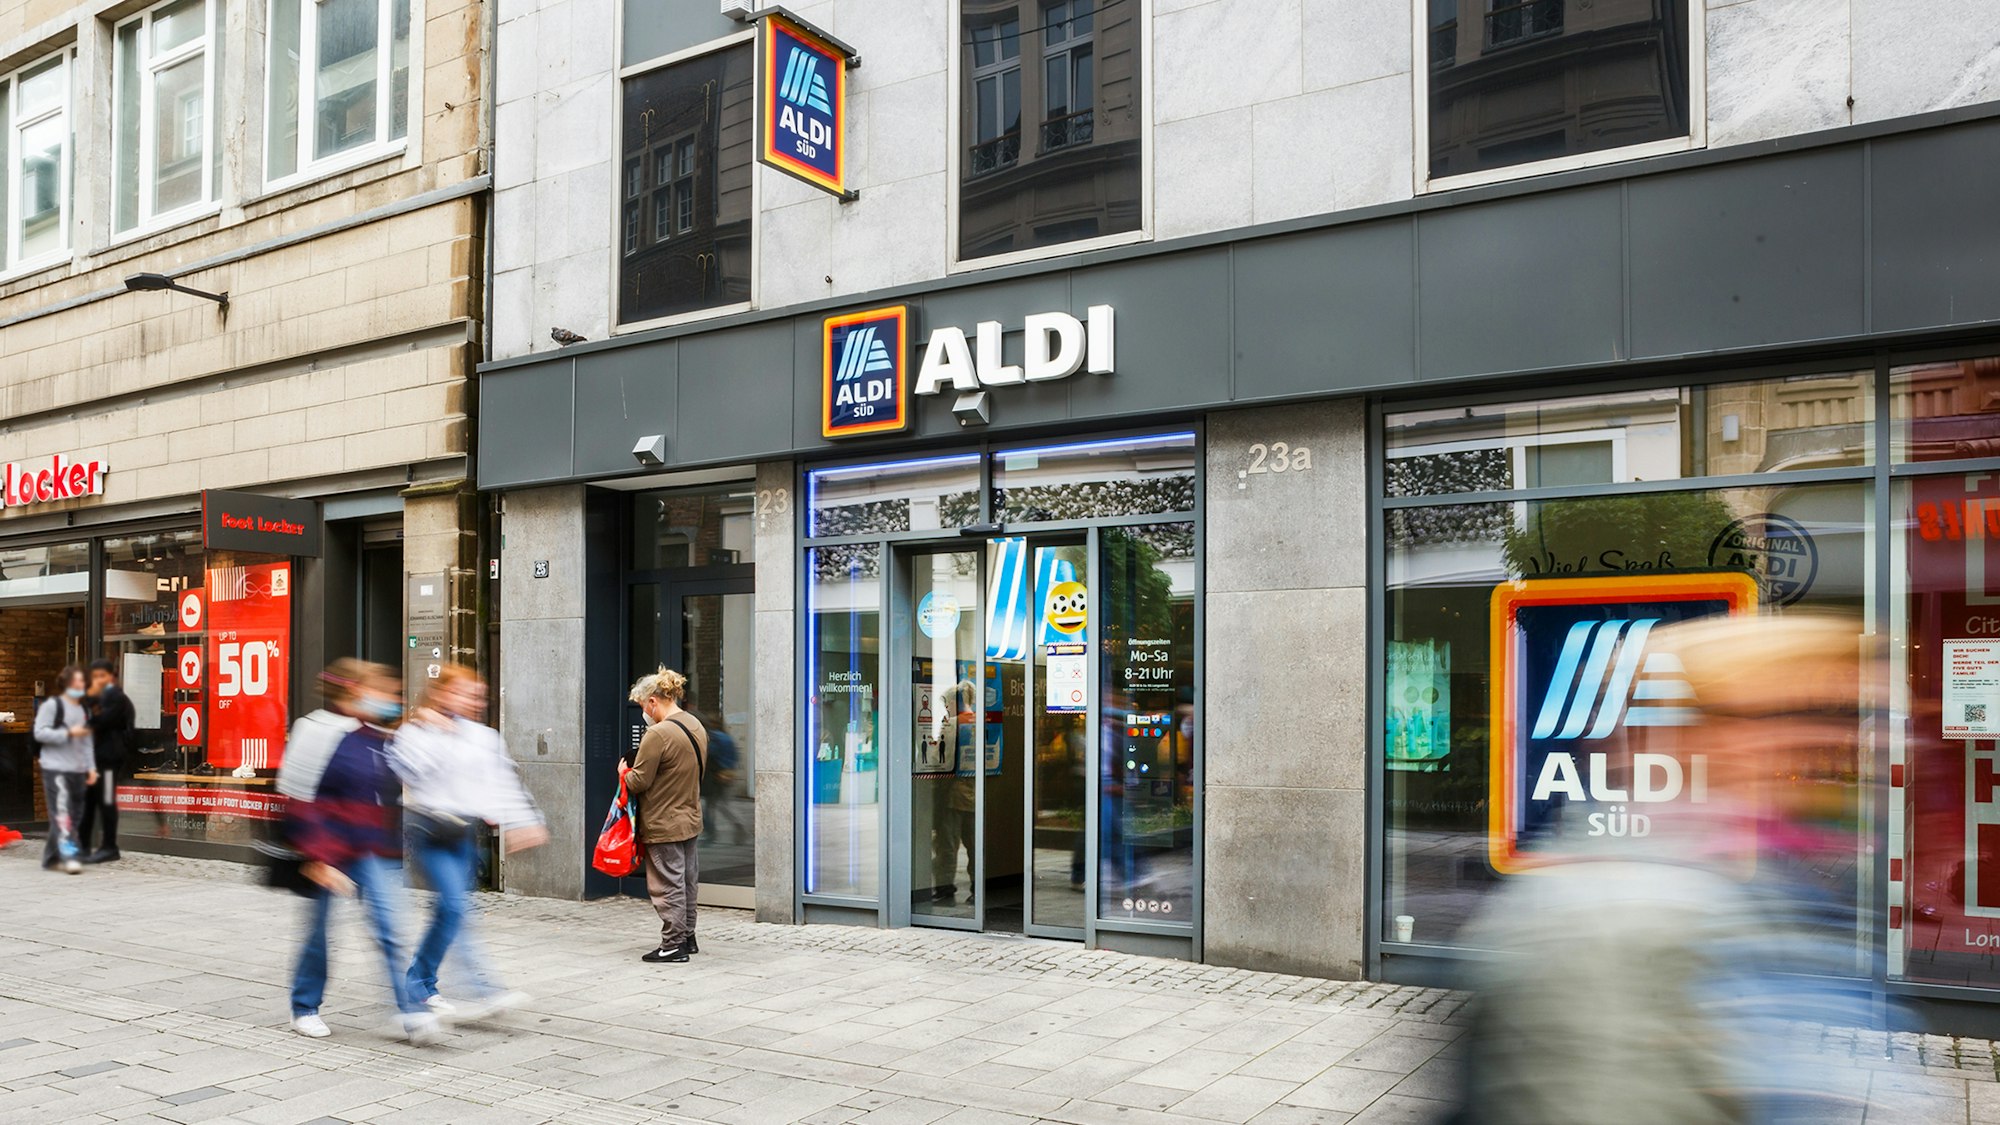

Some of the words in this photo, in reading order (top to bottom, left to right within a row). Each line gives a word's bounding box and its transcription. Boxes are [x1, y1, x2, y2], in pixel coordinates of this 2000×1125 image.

[779, 105, 832, 151] ALDI
[796, 139, 816, 159] SÜD
[914, 304, 1115, 396] ALDI
[836, 377, 893, 407] ALDI
[853, 404, 875, 418] SÜD
[1248, 442, 1312, 475] 23a
[5, 453, 107, 508] Locker
[759, 488, 788, 514] 23
[221, 512, 254, 531] Foot
[257, 516, 305, 535] Locker
[1732, 535, 1799, 553] ORIGINAL
[1530, 551, 1588, 575] Viel
[1599, 550, 1676, 572] Spaß
[219, 632, 227, 641] UP
[228, 631, 237, 640] TO
[1127, 637, 1171, 646] Öffnungszeiten
[218, 640, 280, 697] 50%
[828, 671, 862, 681] Herzlich
[1152, 667, 1174, 680] Uhr
[819, 683, 873, 693] willkommen!
[1531, 752, 1708, 804] ALDI
[140, 794, 153, 803] SALE
[159, 795, 174, 805] FOOT
[174, 796, 195, 806] LOCKER
[202, 797, 217, 807] SALE
[224, 798, 239, 808] FOOT
[239, 799, 263, 811] LOCKER
[1587, 805, 1651, 838] SÜD
